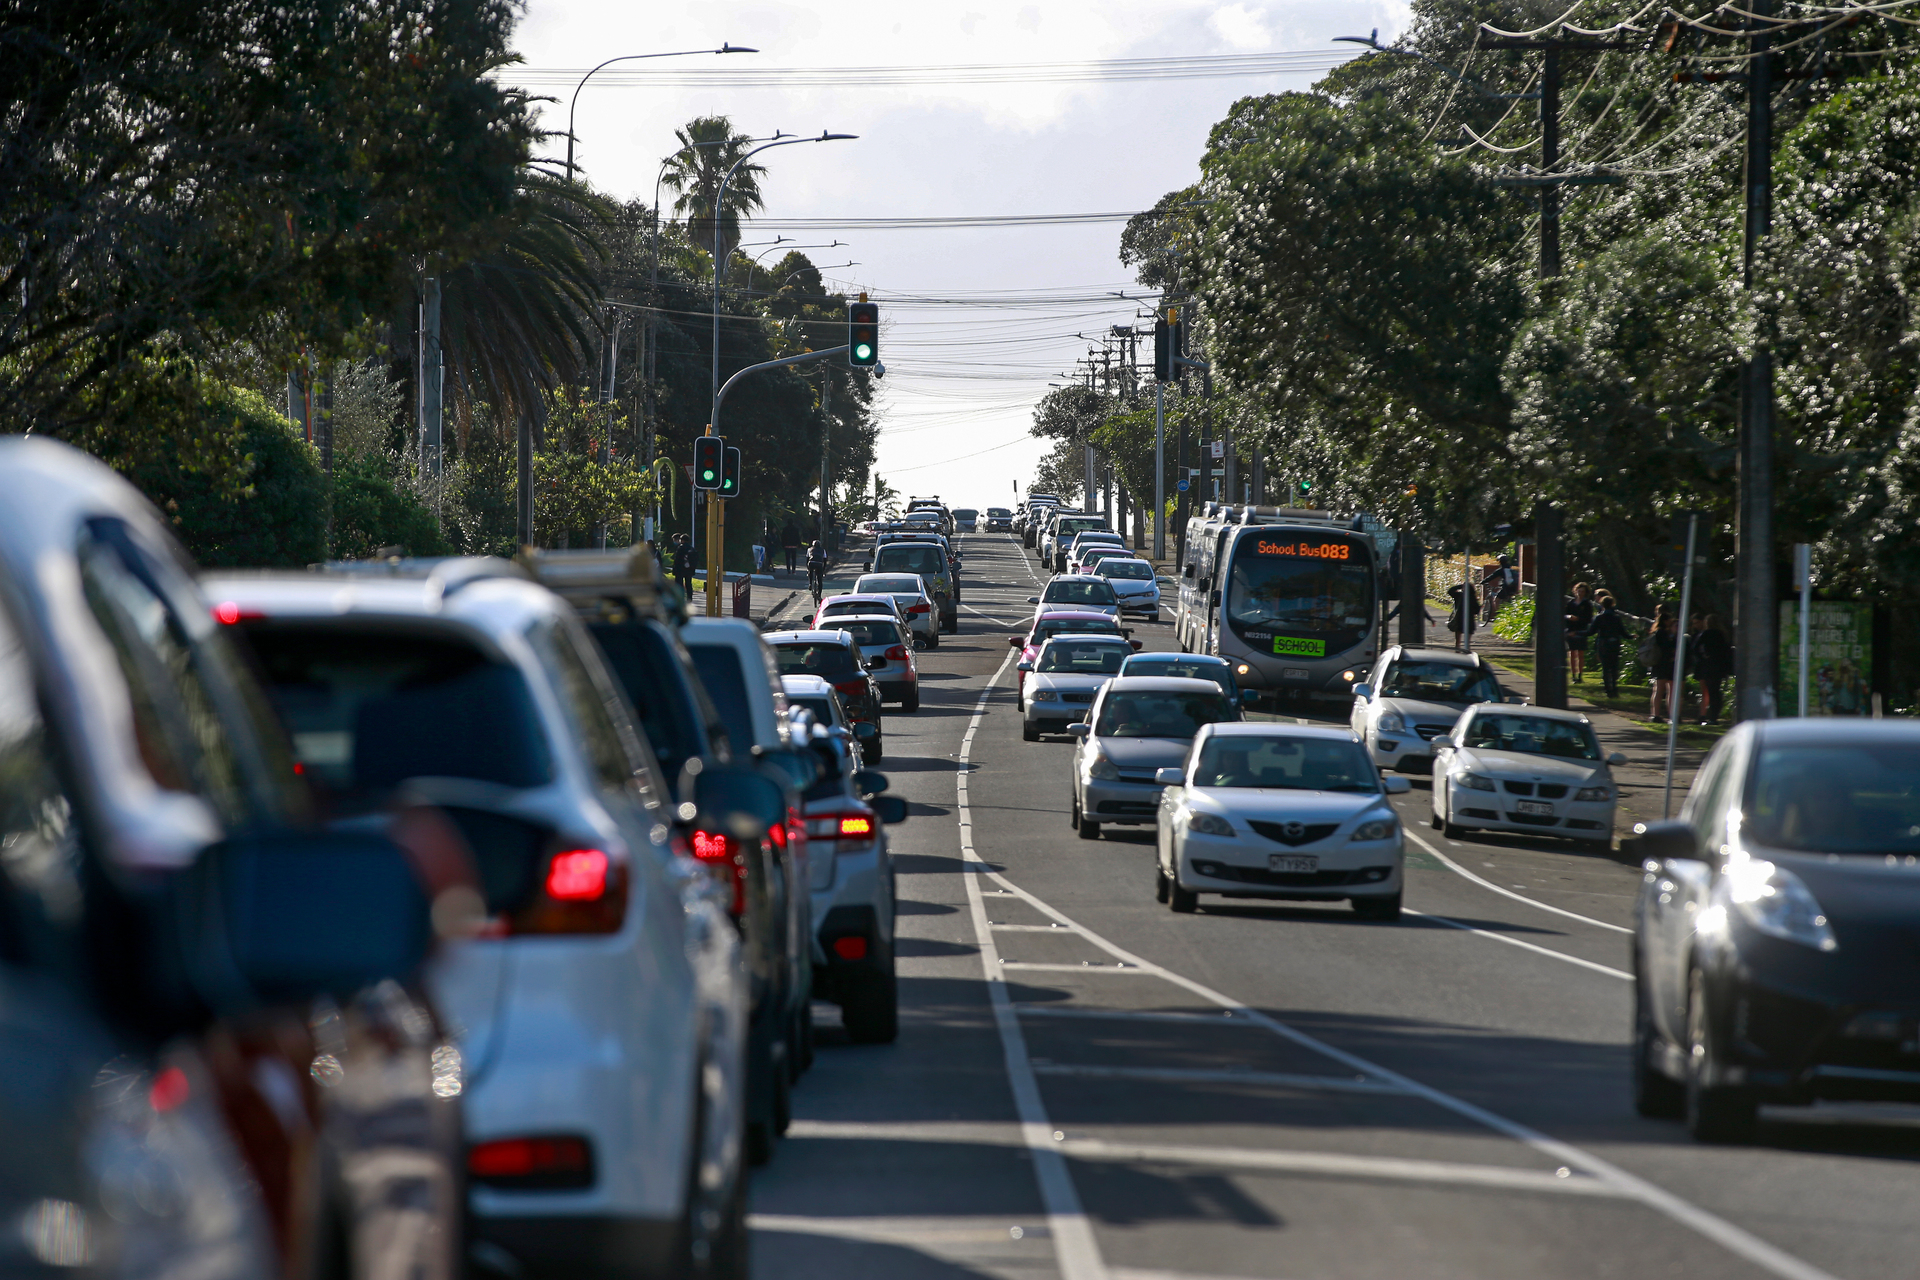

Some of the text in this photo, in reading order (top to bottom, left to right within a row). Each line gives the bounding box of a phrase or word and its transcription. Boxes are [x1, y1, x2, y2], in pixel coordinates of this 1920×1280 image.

[1258, 540, 1350, 560] School Bus 083
[1277, 639, 1321, 653] SCHOOL
